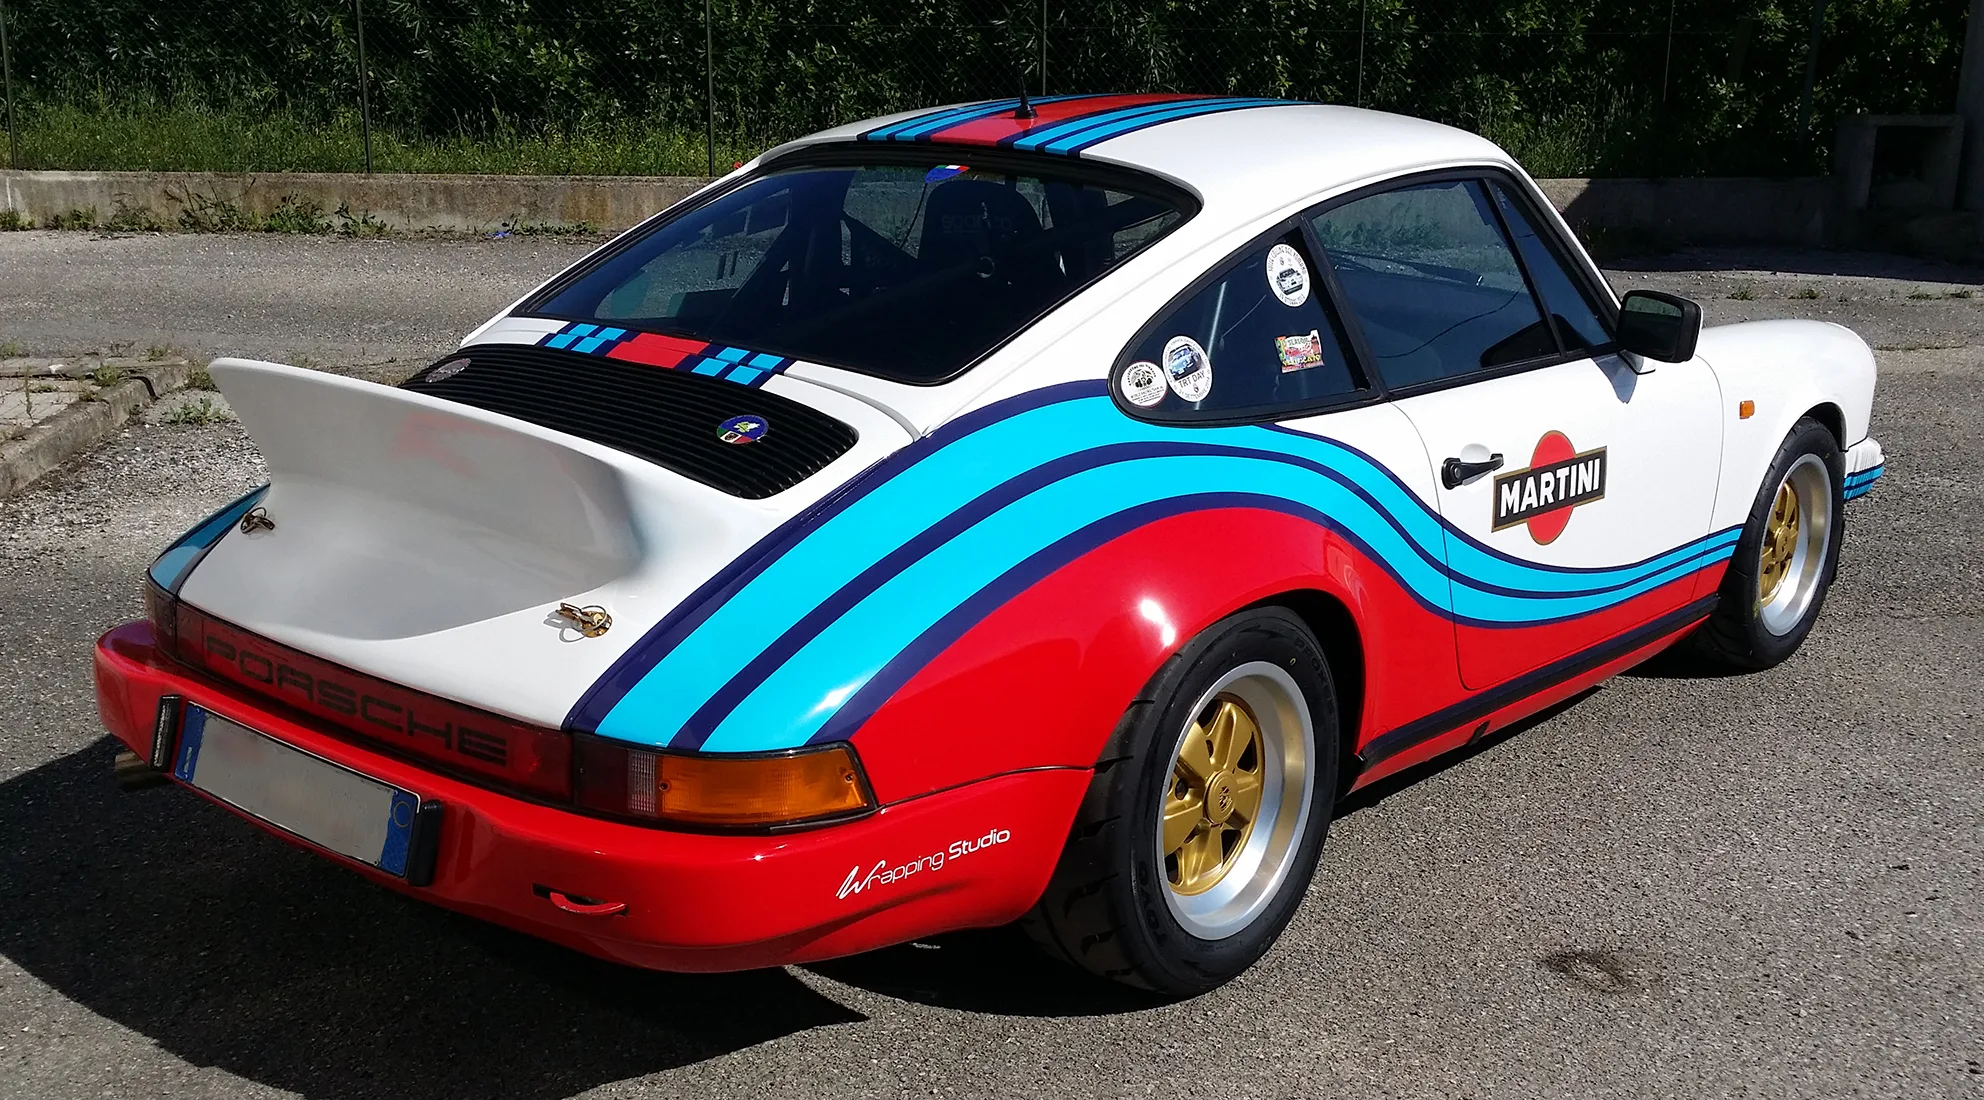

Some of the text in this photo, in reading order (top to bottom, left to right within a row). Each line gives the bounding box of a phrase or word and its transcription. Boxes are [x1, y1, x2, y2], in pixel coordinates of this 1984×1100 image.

[942, 214, 1013, 232] sparo
[1178, 370, 1205, 388] TRT DAY
[1499, 457, 1601, 518] MARTINI
[207, 635, 508, 767] PORSCHE
[835, 828, 1011, 900] Wrapping Studio
